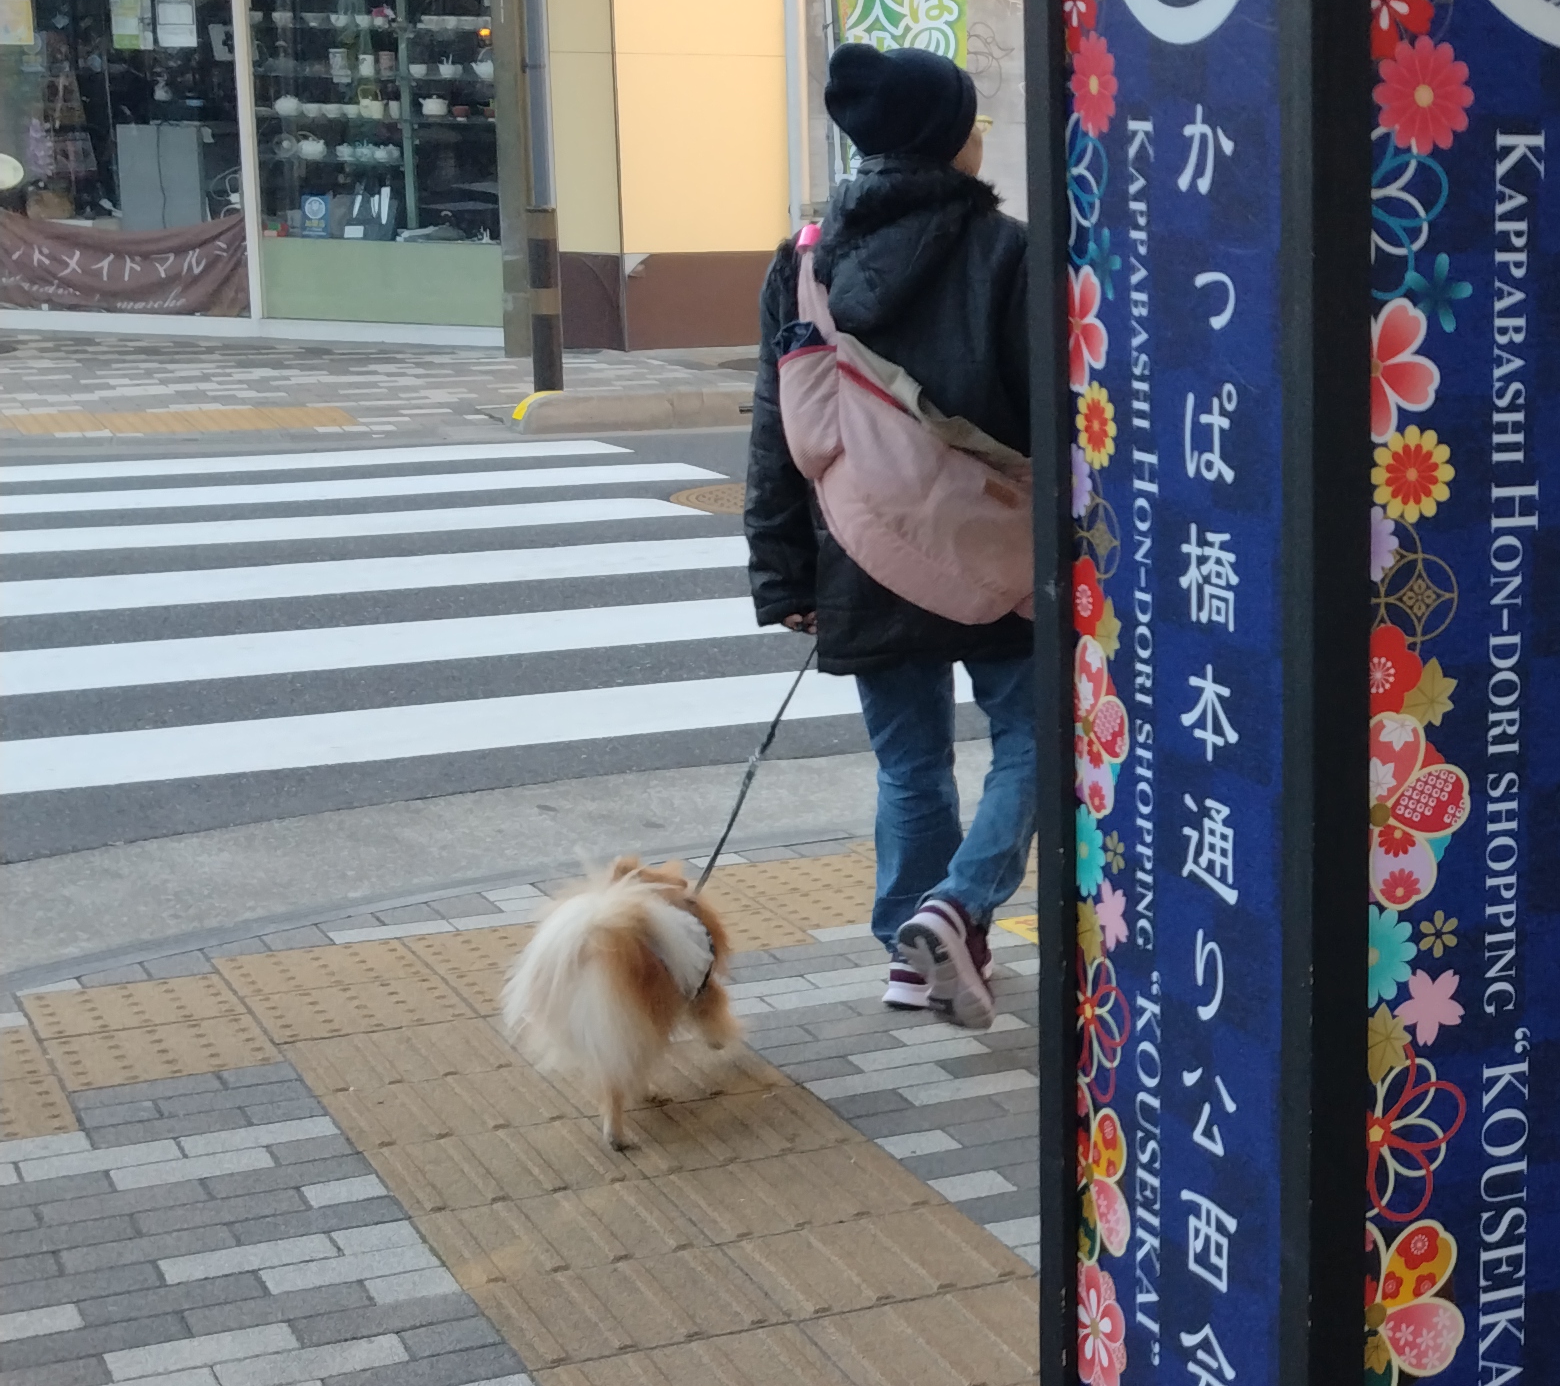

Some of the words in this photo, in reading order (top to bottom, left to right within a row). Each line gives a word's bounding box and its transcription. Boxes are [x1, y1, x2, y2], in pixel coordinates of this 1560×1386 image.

[1126, 116, 1155, 431] KAPPABASHI
[1491, 128, 1545, 463] KAPPABASHI
[1130, 448, 1159, 705] HON-DORI
[1488, 480, 1539, 756] HON-DORI
[1133, 719, 1154, 951] SHOPPING
[1482, 771, 1520, 1016] SHOPPING
